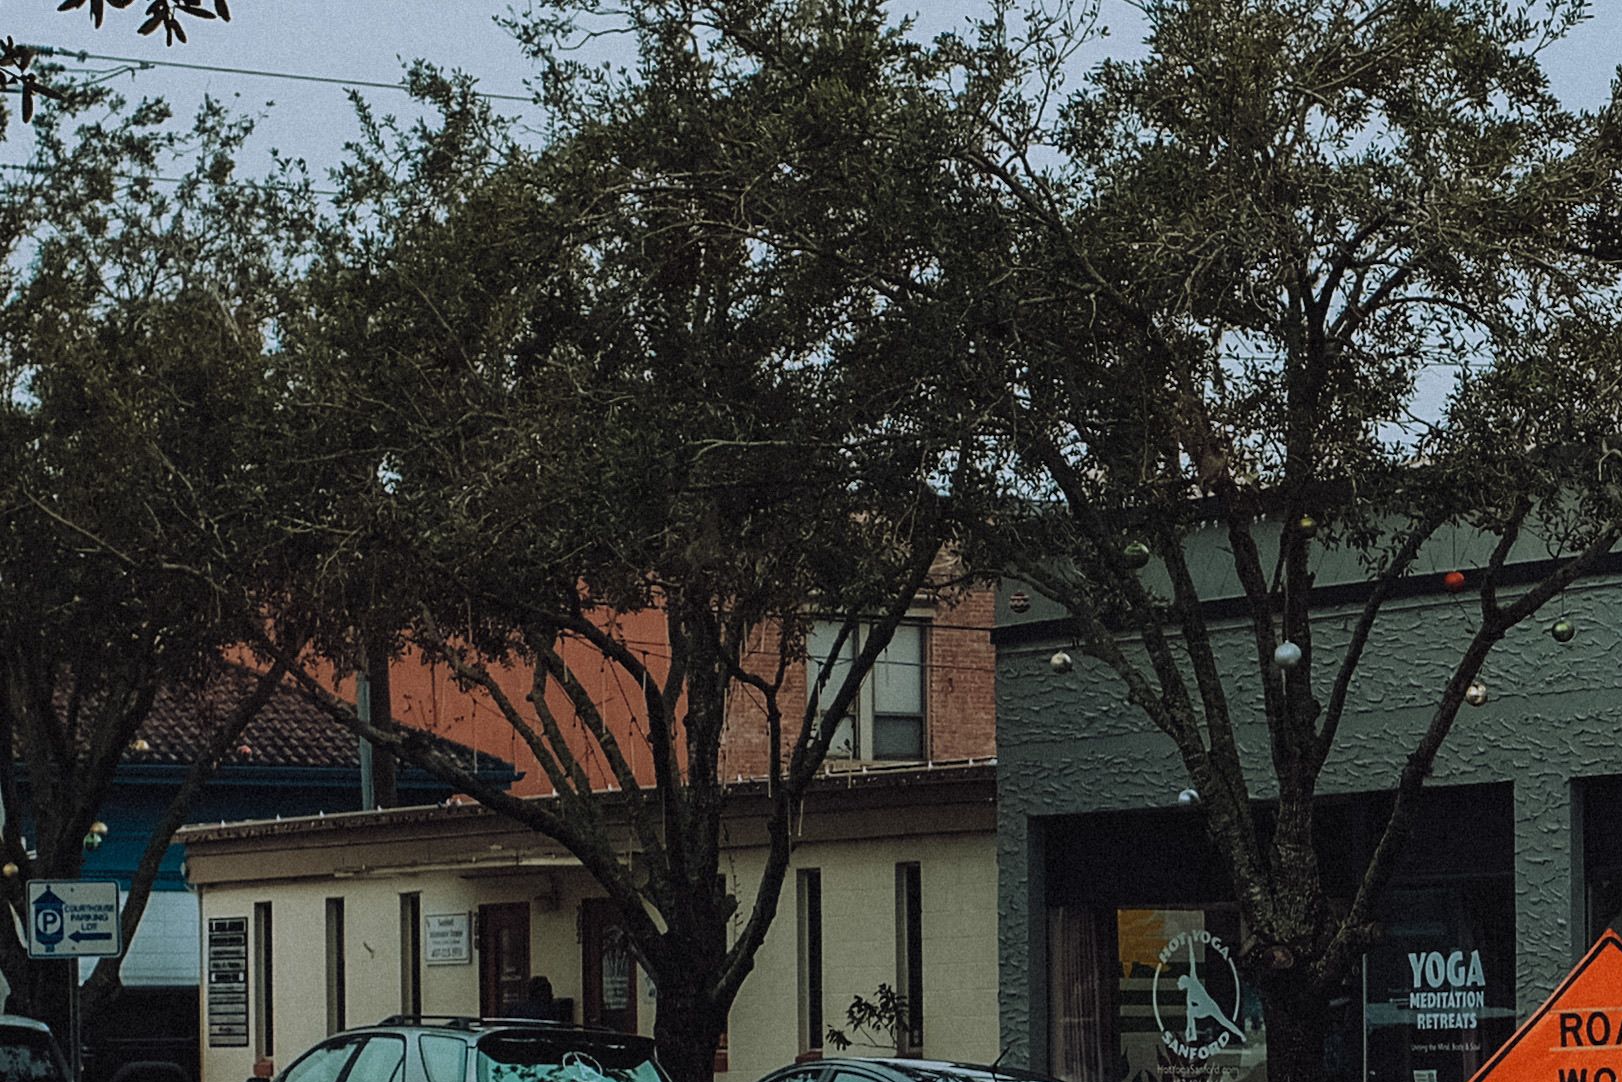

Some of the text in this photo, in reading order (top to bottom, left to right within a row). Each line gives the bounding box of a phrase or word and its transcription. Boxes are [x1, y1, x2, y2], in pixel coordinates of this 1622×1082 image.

[64, 903, 114, 913] COURTHOUSE
[70, 913, 109, 922] PARKING
[80, 922, 98, 931] LOT
[1159, 929, 1230, 963] HOT YOGA
[1408, 950, 1486, 988] YOGA
[1409, 991, 1485, 1008] MEDITATION
[1417, 1013, 1477, 1030] RETREATS
[1161, 1030, 1230, 1060] SANFORD
